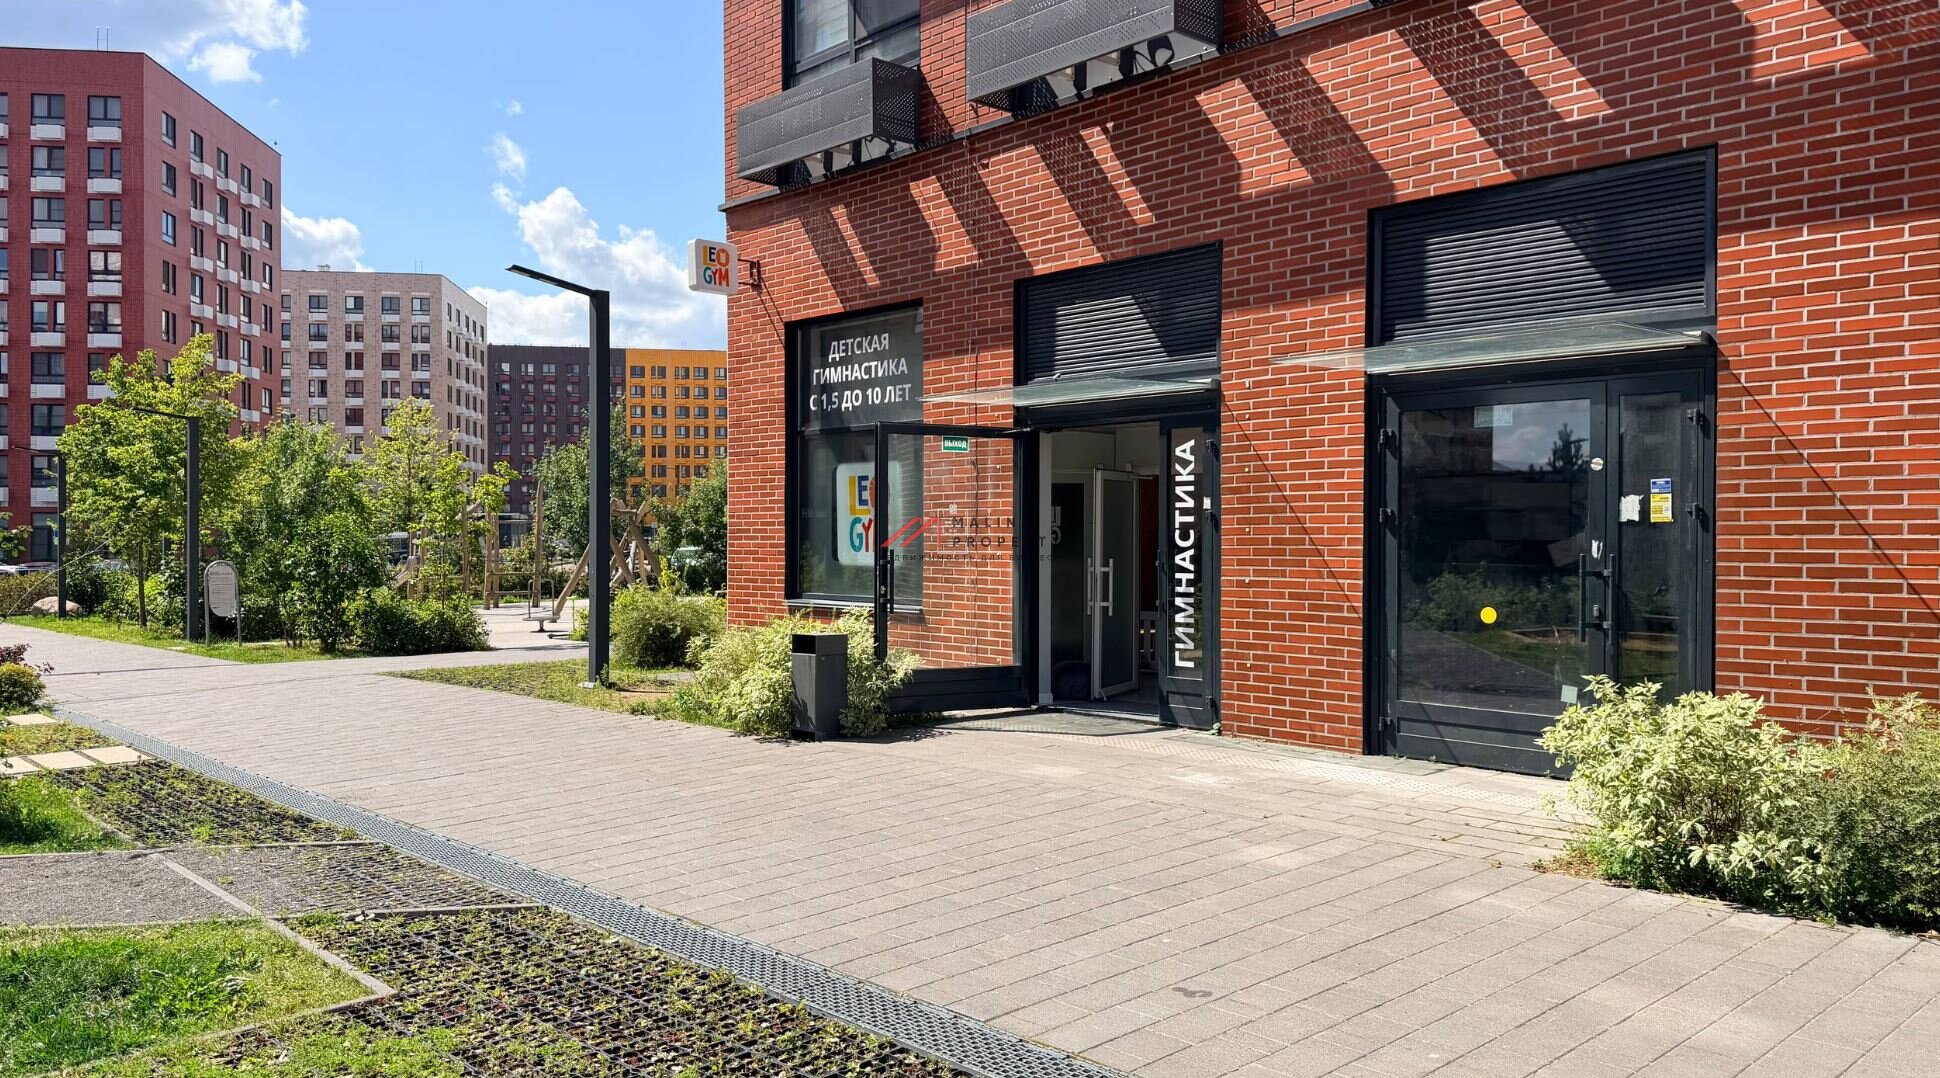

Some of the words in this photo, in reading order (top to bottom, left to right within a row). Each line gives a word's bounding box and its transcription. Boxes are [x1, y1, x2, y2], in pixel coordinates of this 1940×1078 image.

[702, 245, 730, 267] LEO
[703, 266, 730, 288] GYM
[828, 333, 889, 362] ДЕТСКАЯ
[813, 357, 908, 386] ГИМНАСТИКА
[809, 394, 818, 411] С
[821, 391, 839, 412] 1,5
[841, 389, 863, 412] ДО
[866, 387, 882, 405] 10
[884, 383, 912, 403] ЛЕТ
[943, 439, 968, 449] ВЫХОД
[849, 516, 876, 553] GY
[1174, 438, 1195, 668] ГИМНАСТИКА
